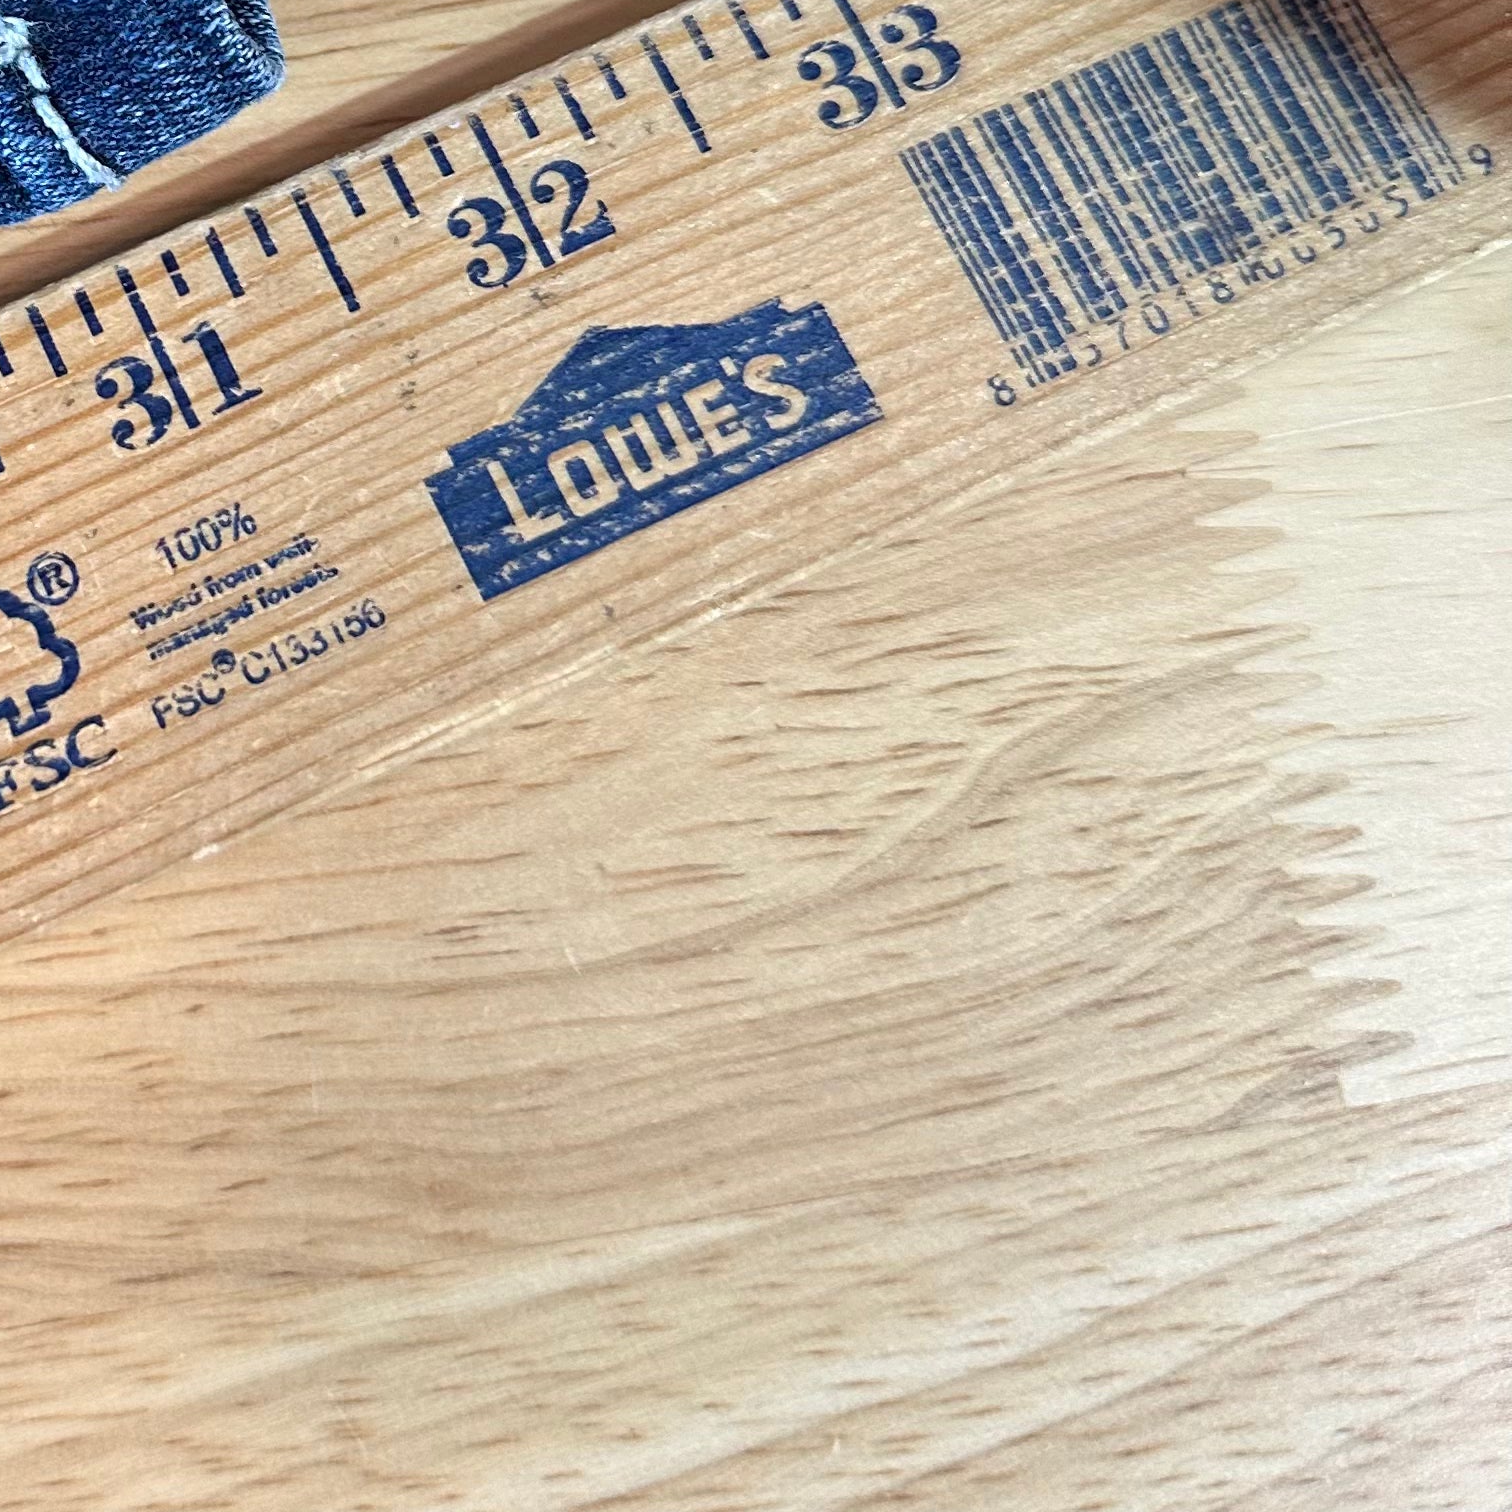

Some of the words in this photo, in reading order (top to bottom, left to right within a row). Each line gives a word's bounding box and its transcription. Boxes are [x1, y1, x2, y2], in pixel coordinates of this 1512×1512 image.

[798, 2, 964, 131] 33
[446, 159, 617, 288] 32
[1467, 143, 1492, 176] 9
[95, 319, 263, 451] 31
[487, 353, 808, 543] LOWE'S
[155, 502, 257, 570] 100%
